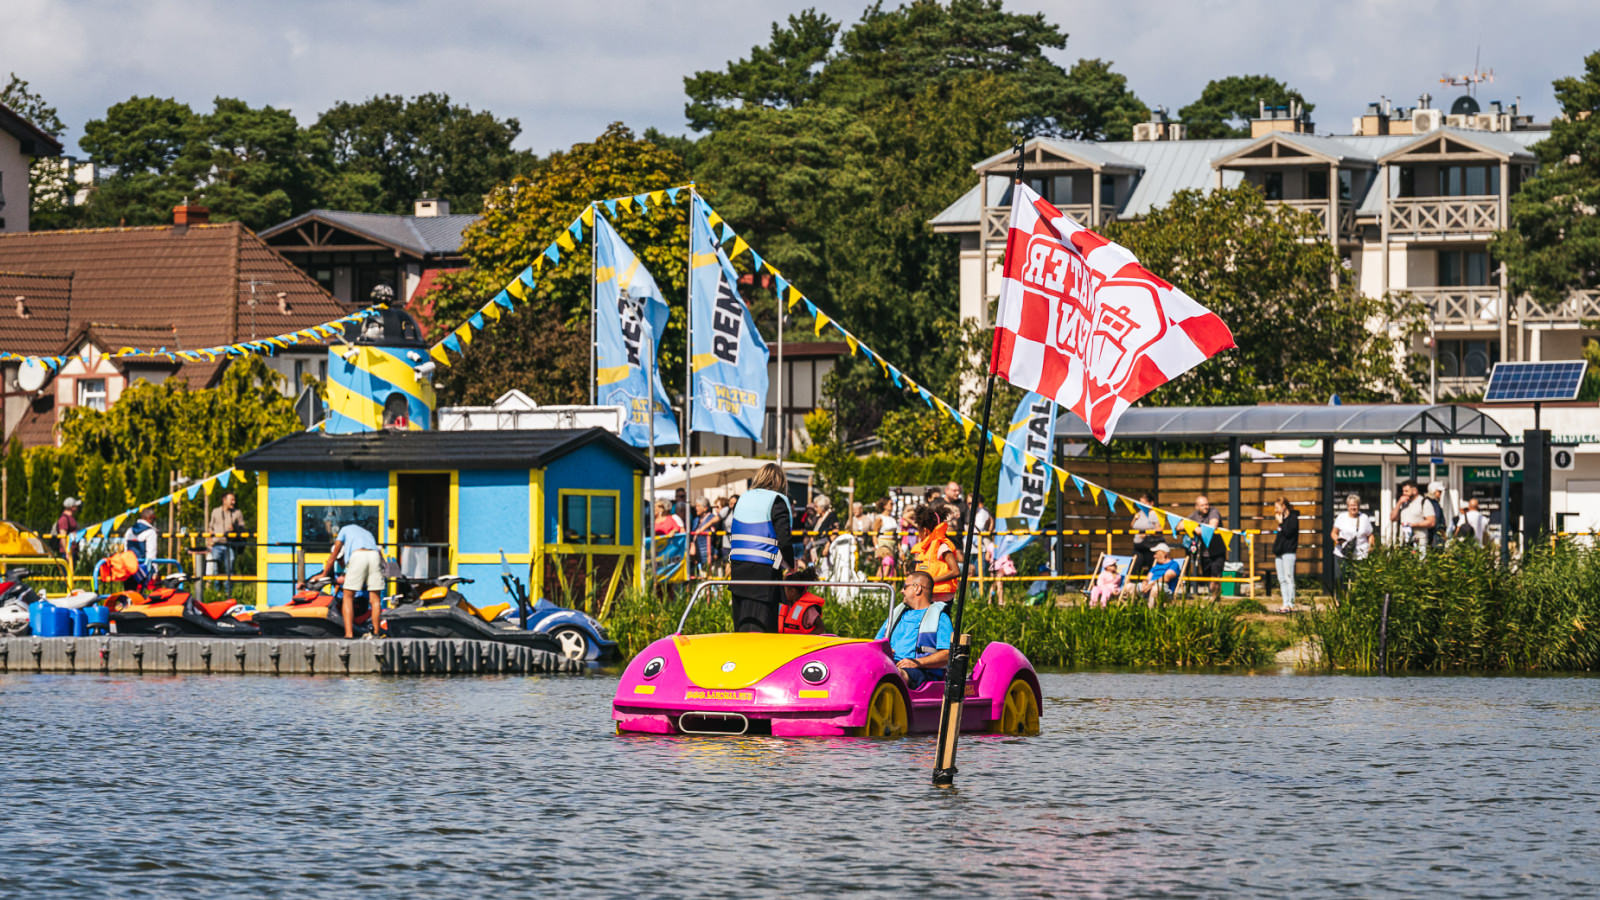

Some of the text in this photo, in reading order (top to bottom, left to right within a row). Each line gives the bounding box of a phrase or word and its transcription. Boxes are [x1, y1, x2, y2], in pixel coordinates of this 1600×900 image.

[714, 384, 757, 407] WATER
[717, 398, 740, 415] FUN
[1335, 469, 1365, 479] ELISA
[1476, 469, 1515, 479] MELIA
